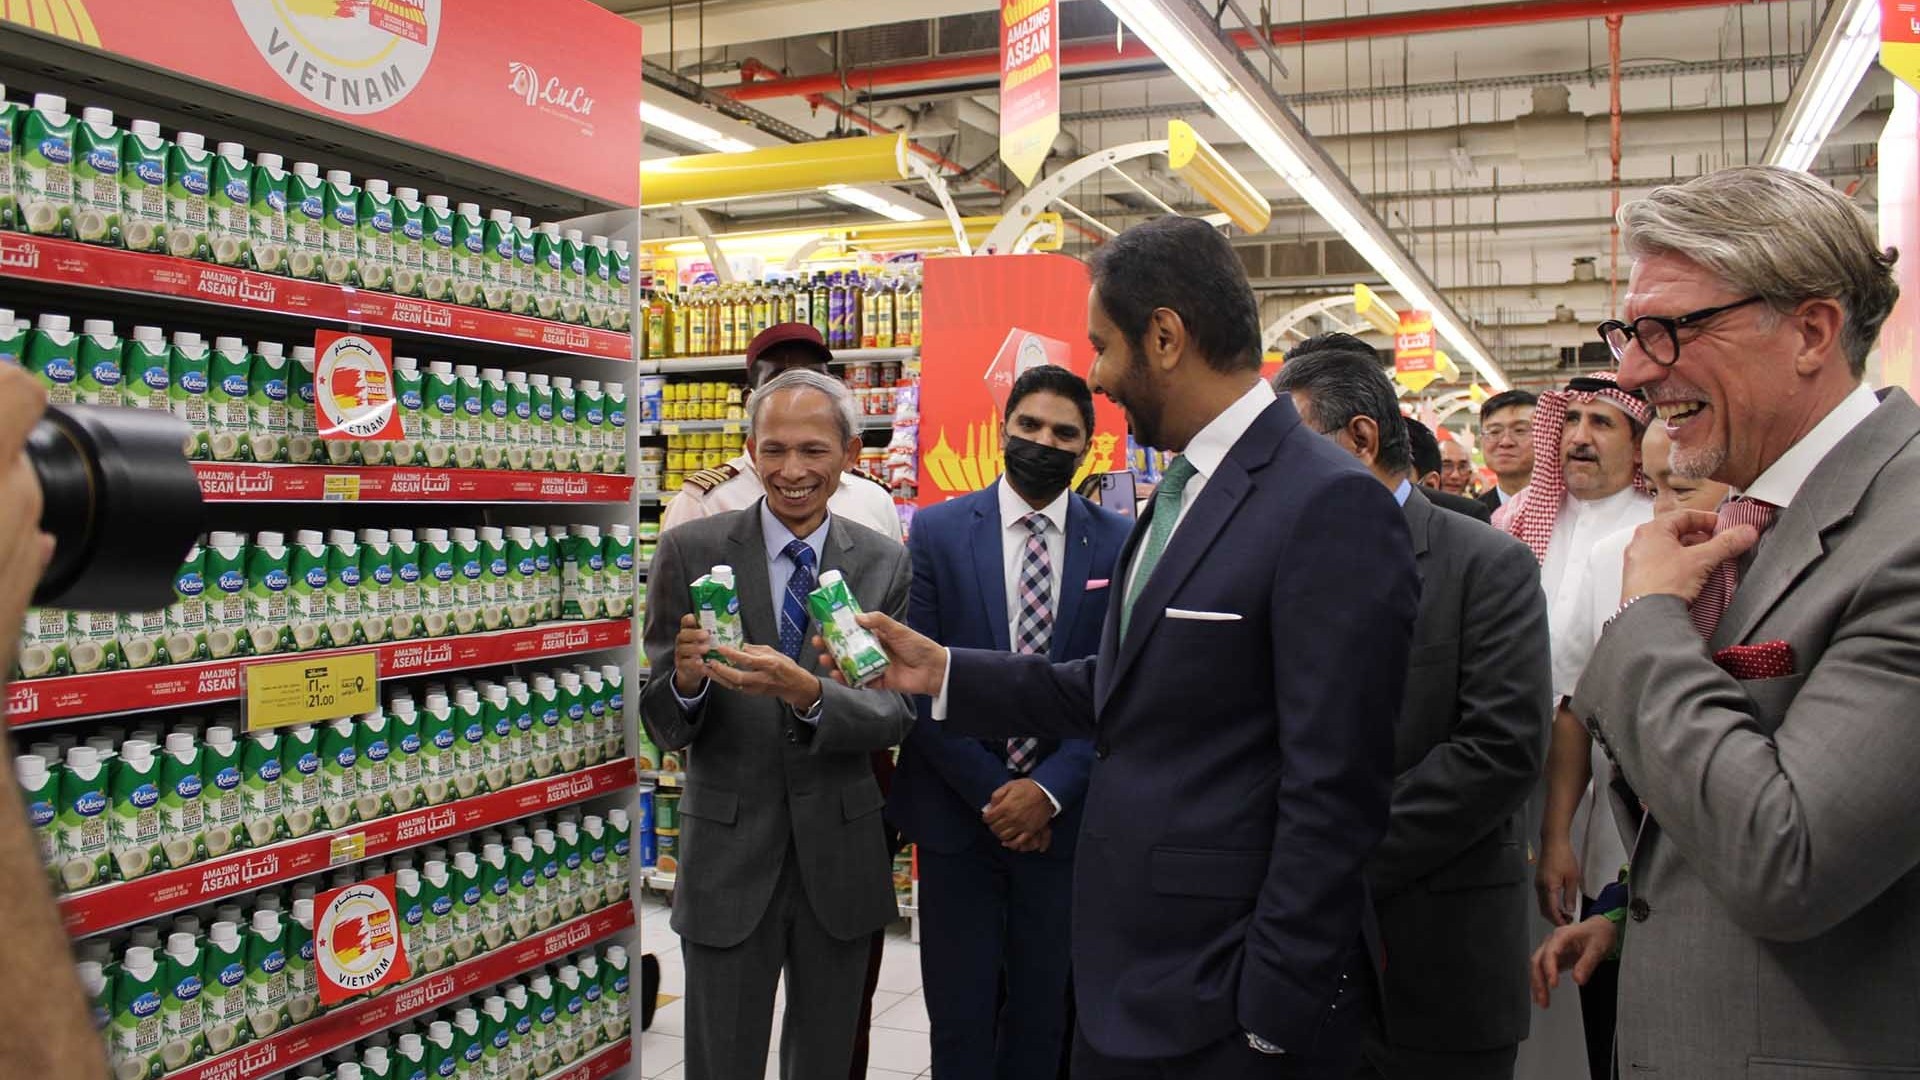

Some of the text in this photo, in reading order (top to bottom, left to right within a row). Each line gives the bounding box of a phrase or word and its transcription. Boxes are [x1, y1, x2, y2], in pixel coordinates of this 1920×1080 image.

[1007, 7, 1050, 46] AMAZING
[1006, 26, 1050, 72] ASEAN
[267, 26, 406, 106] VIETNAM
[541, 76, 595, 115] LuLu
[200, 269, 238, 285] AMAZING
[197, 279, 236, 298] ASEAN
[395, 302, 422, 313] AMAZING
[392, 310, 421, 324] ASEAN
[47, 363, 76, 379] Rubicon
[93, 366, 120, 381] Rubicon
[336, 415, 386, 435] VETNAM
[197, 471, 235, 481] AMAZING
[392, 473, 420, 481] AMAZING
[391, 481, 420, 492] ASEAN
[540, 485, 564, 494] ASEAN
[178, 579, 204, 593] Rubicon
[217, 576, 243, 589] Rubicon
[265, 575, 288, 588] Rubicon
[143, 616, 162, 628] WATER
[183, 612, 203, 623] WATER
[40, 623, 64, 634] WATER
[91, 620, 113, 631] WATER
[541, 639, 565, 650] ASEAN
[393, 647, 423, 658] AMAZING
[392, 655, 422, 669] ASEAN
[199, 668, 237, 679] AMAZING
[198, 677, 237, 694] ASEAN
[308, 695, 335, 708] 21.00
[216, 773, 239, 788] Rubicon
[177, 781, 202, 796] Rubicon
[546, 788, 570, 803] ASEAN
[77, 797, 106, 813] Rubicon
[131, 790, 158, 805] Rubicon
[397, 816, 426, 830] AMAZING
[137, 826, 157, 837] WATER
[397, 825, 426, 842] ASEAN
[81, 834, 104, 846] WATER
[203, 863, 240, 881] AMAZING
[201, 874, 240, 894] ASEAN
[544, 939, 568, 955] ASEAN
[263, 957, 286, 971] Rubicon
[220, 969, 244, 983] Rubicon
[338, 957, 391, 988] VIETNAM
[177, 983, 202, 998] Rubicon
[396, 986, 425, 1004] AMAZING
[133, 999, 160, 1015] Rubicon
[395, 995, 425, 1015] ASEAN
[136, 1033, 159, 1047] WATER
[200, 1058, 238, 1080] AMAZING
